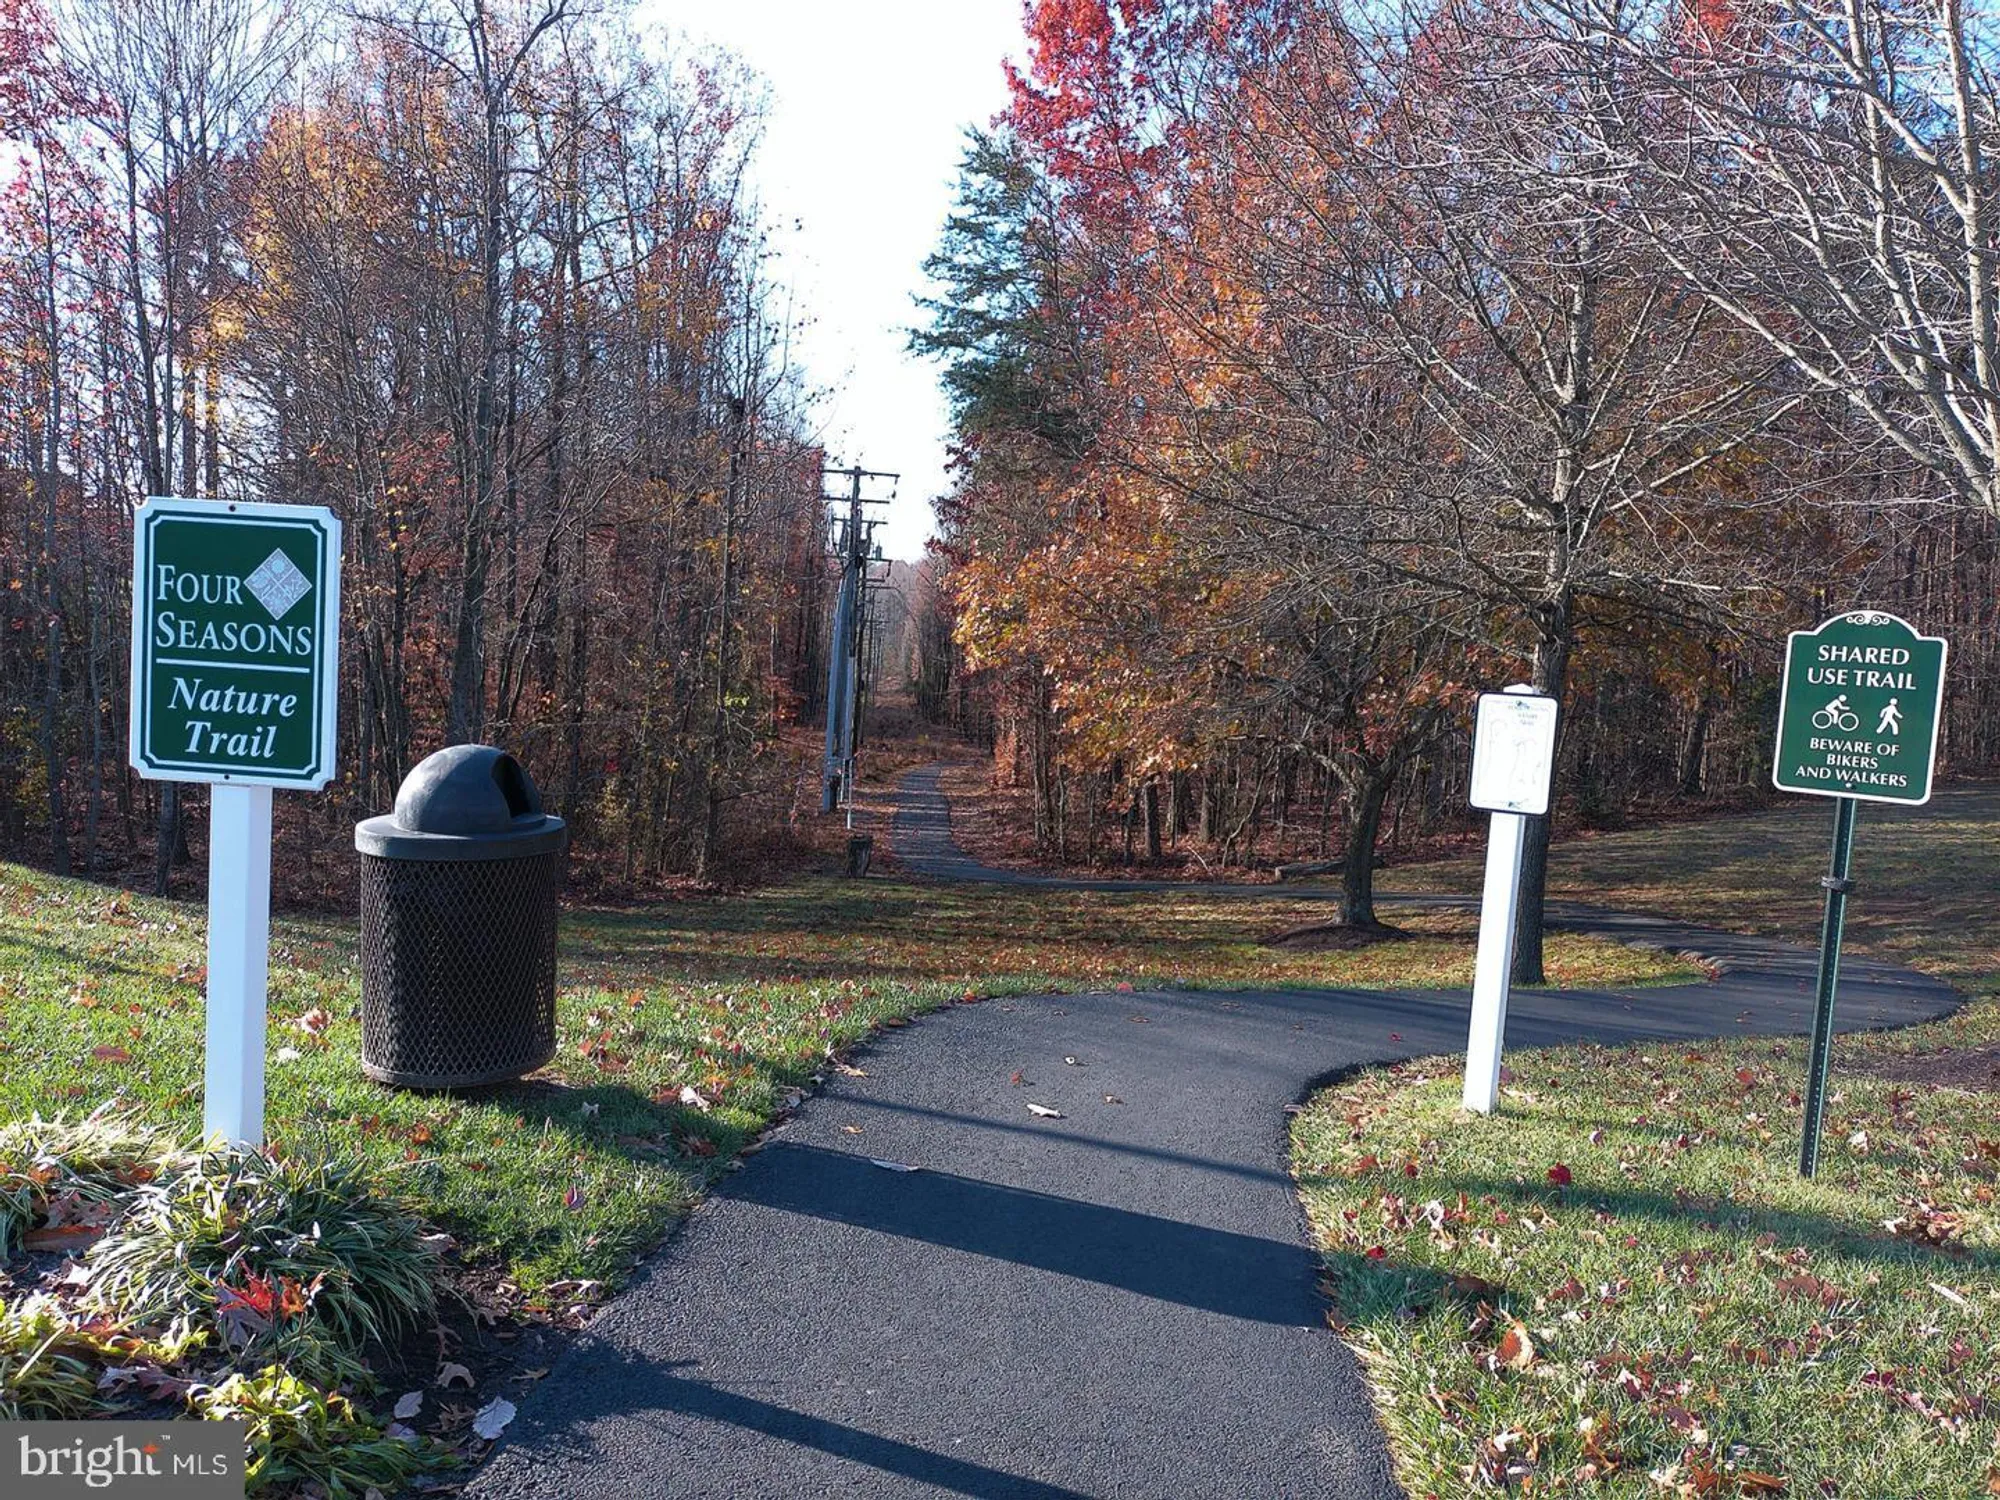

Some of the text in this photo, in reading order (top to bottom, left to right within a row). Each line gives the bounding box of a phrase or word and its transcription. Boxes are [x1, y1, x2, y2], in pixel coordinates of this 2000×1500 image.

[157, 564, 243, 605] FOUR
[155, 611, 312, 655] SEASONS
[1818, 644, 1910, 665] SHARED
[1807, 667, 1917, 690] USE TRAIL
[167, 677, 298, 718] Nature
[185, 720, 277, 759] Trail
[1809, 737, 1900, 757] BEWARE OF
[1826, 753, 1879, 770] BIKERS
[1795, 765, 1908, 788] AND WALKERS
